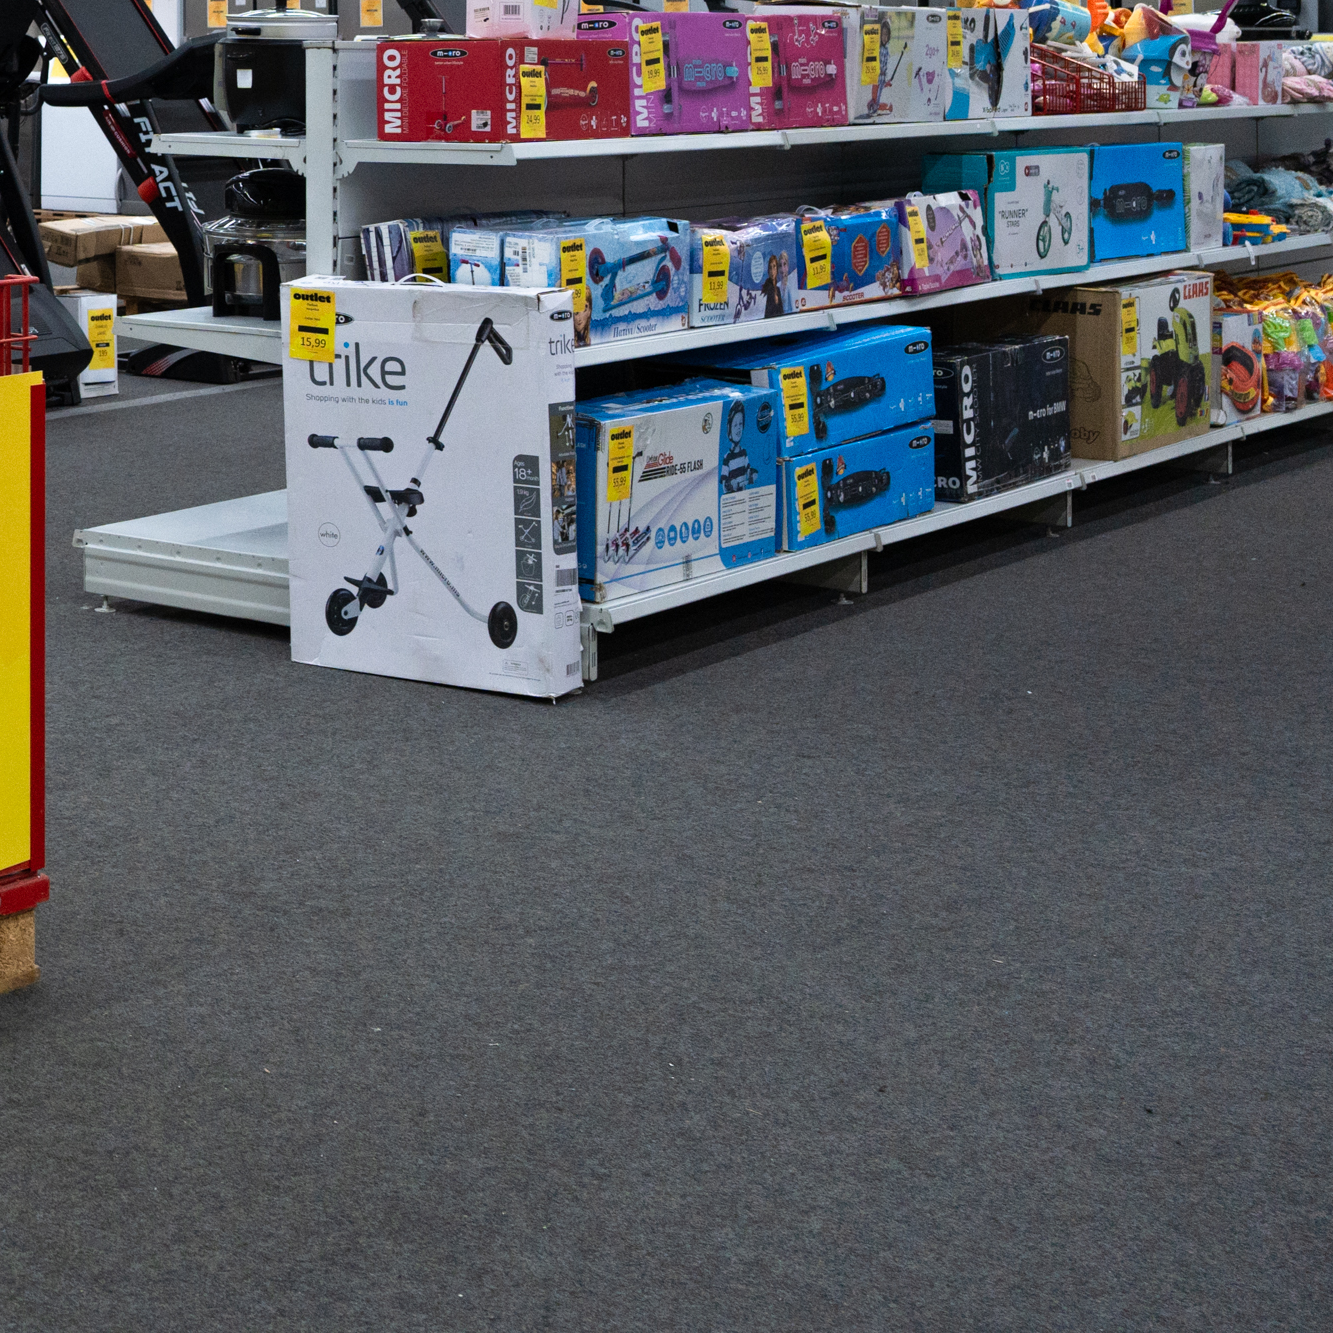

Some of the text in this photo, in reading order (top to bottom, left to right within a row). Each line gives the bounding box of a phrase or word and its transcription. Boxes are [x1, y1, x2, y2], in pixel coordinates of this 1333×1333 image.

[641, 26, 659, 36] outlet
[750, 26, 768, 35] outlet
[522, 69, 542, 78] outlet
[383, 48, 402, 134] MICRO
[506, 47, 517, 134] MICRO
[150, 164, 183, 212] ACT
[802, 224, 824, 237] outlet
[413, 234, 438, 244] outlet
[704, 239, 724, 248] outlet
[562, 243, 583, 253] outlet
[293, 293, 331, 303] outlet
[90, 313, 111, 321] outlet
[300, 337, 326, 349] 15,99
[309, 342, 406, 391] trike
[783, 370, 802, 381] outlet
[306, 394, 339, 404] Shopping
[342, 396, 356, 404] with
[358, 397, 370, 405] the
[372, 397, 387, 405] kids
[388, 398, 395, 406] is
[961, 364, 978, 494] MICRO
[611, 429, 631, 441] outlet
[797, 467, 815, 481] outlet
[319, 531, 338, 540] white
